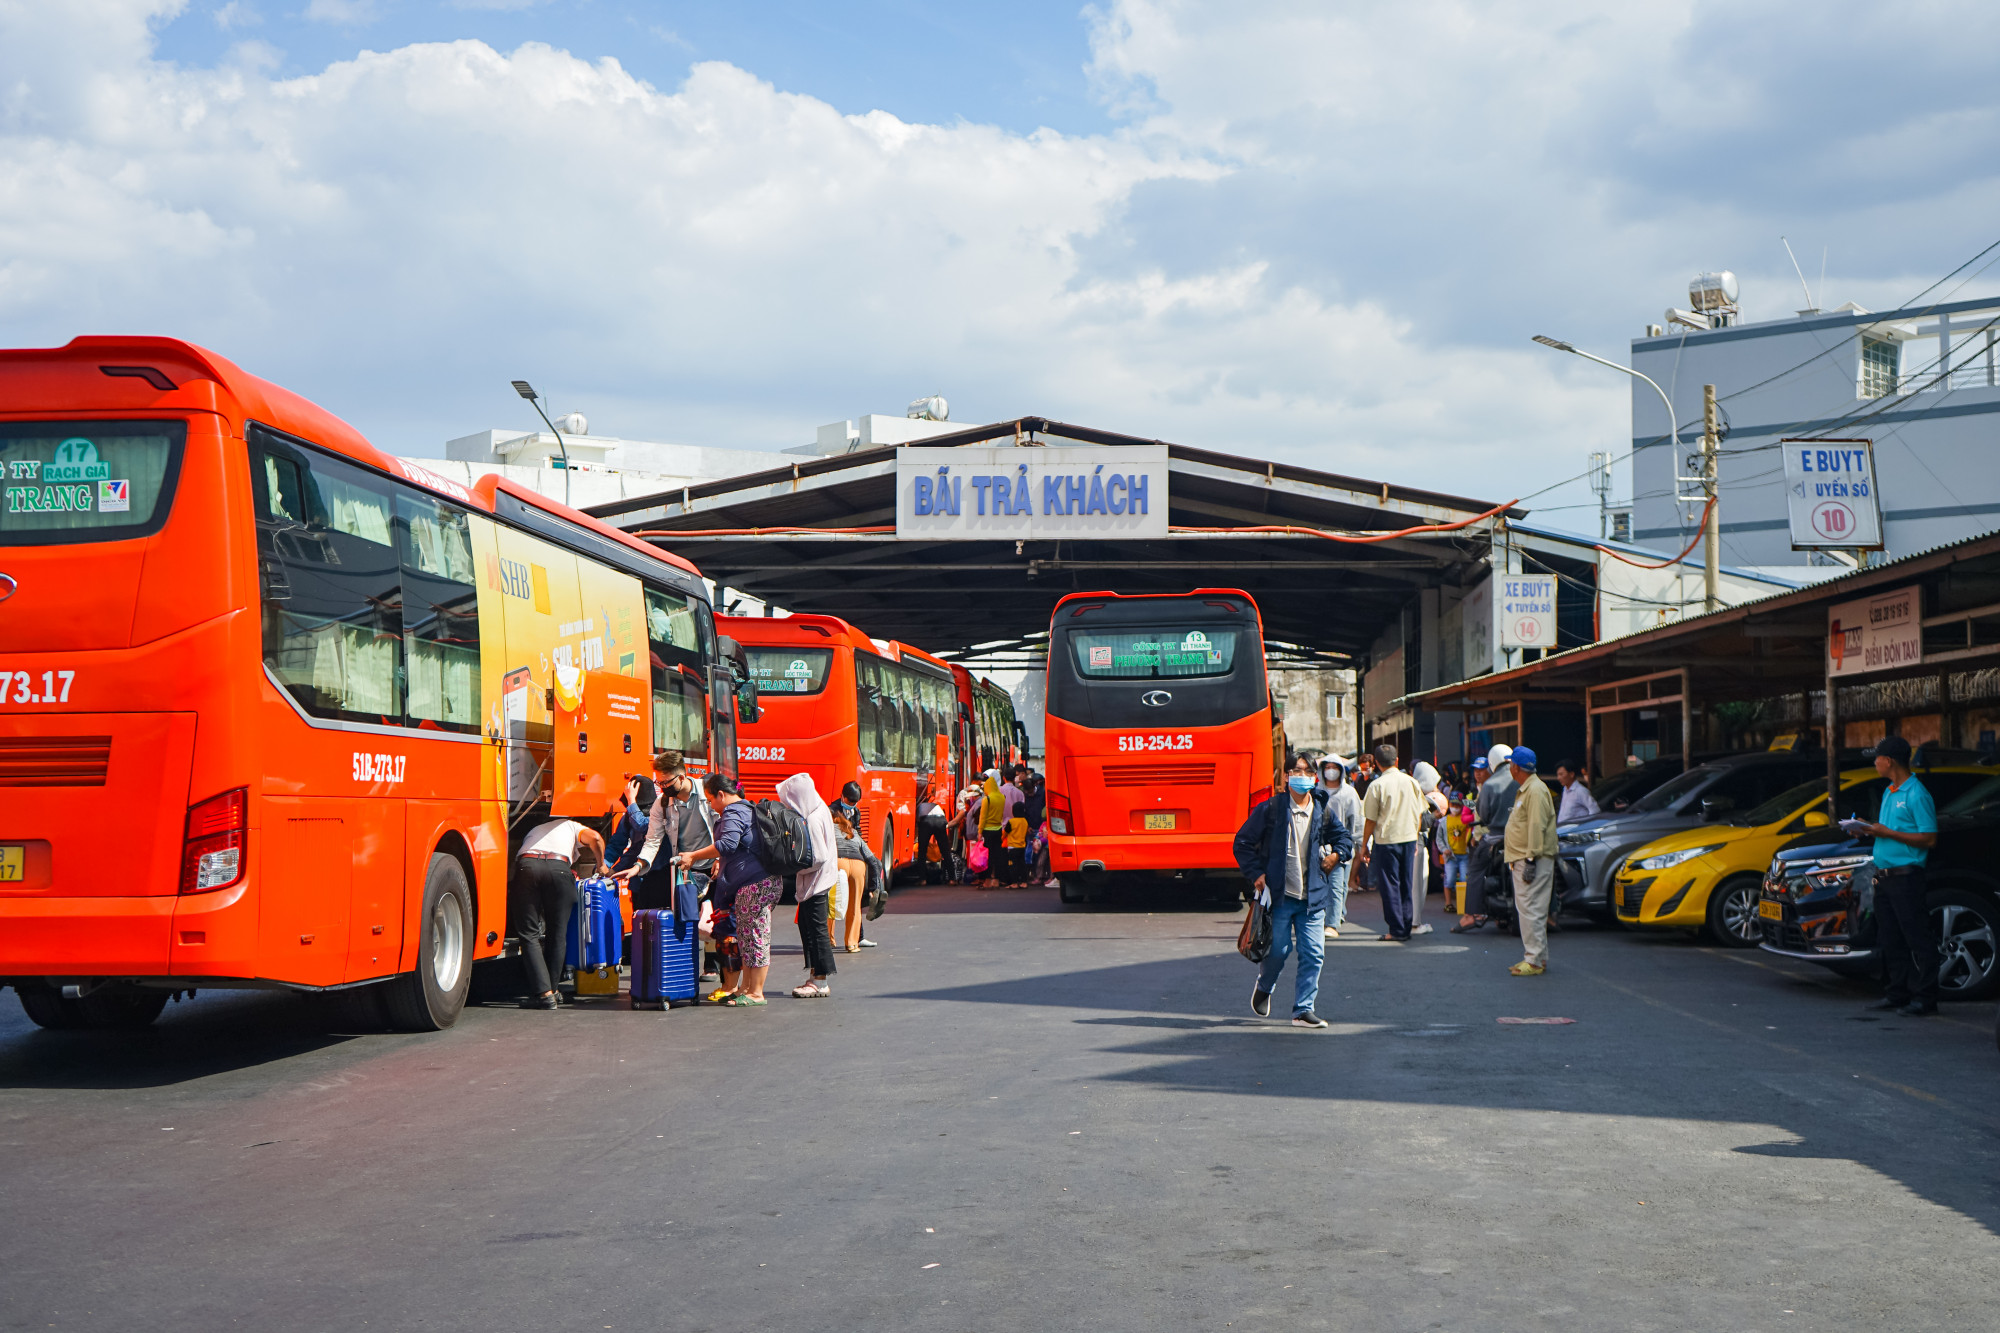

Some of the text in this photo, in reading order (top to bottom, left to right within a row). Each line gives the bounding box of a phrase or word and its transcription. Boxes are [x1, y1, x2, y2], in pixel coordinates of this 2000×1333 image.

[62, 443, 90, 463] 17
[9, 461, 41, 479] TY
[45, 461, 107, 481] RẠCH GIÁ
[914, 464, 1149, 516] BÃI TRẢ KHÁCH
[1852, 476, 1869, 497] SỐ
[6, 485, 93, 513] TRANG
[1821, 509, 1846, 532] 10
[500, 557, 530, 600] SHB
[1505, 579, 1551, 597] XE BUÝT
[1520, 622, 1534, 637] 14
[1132, 641, 1177, 652] CÔNG TY
[1902, 639, 1919, 660] TAXI
[793, 662, 805, 670] 22
[1165, 652, 1205, 666] TRANG
[760, 668, 772, 676] TY
[0, 671, 75, 704] 73.17
[758, 679, 793, 691] TRANG
[1119, 735, 1193, 751] 51B-254.25
[353, 752, 406, 783] 51B-273.17
